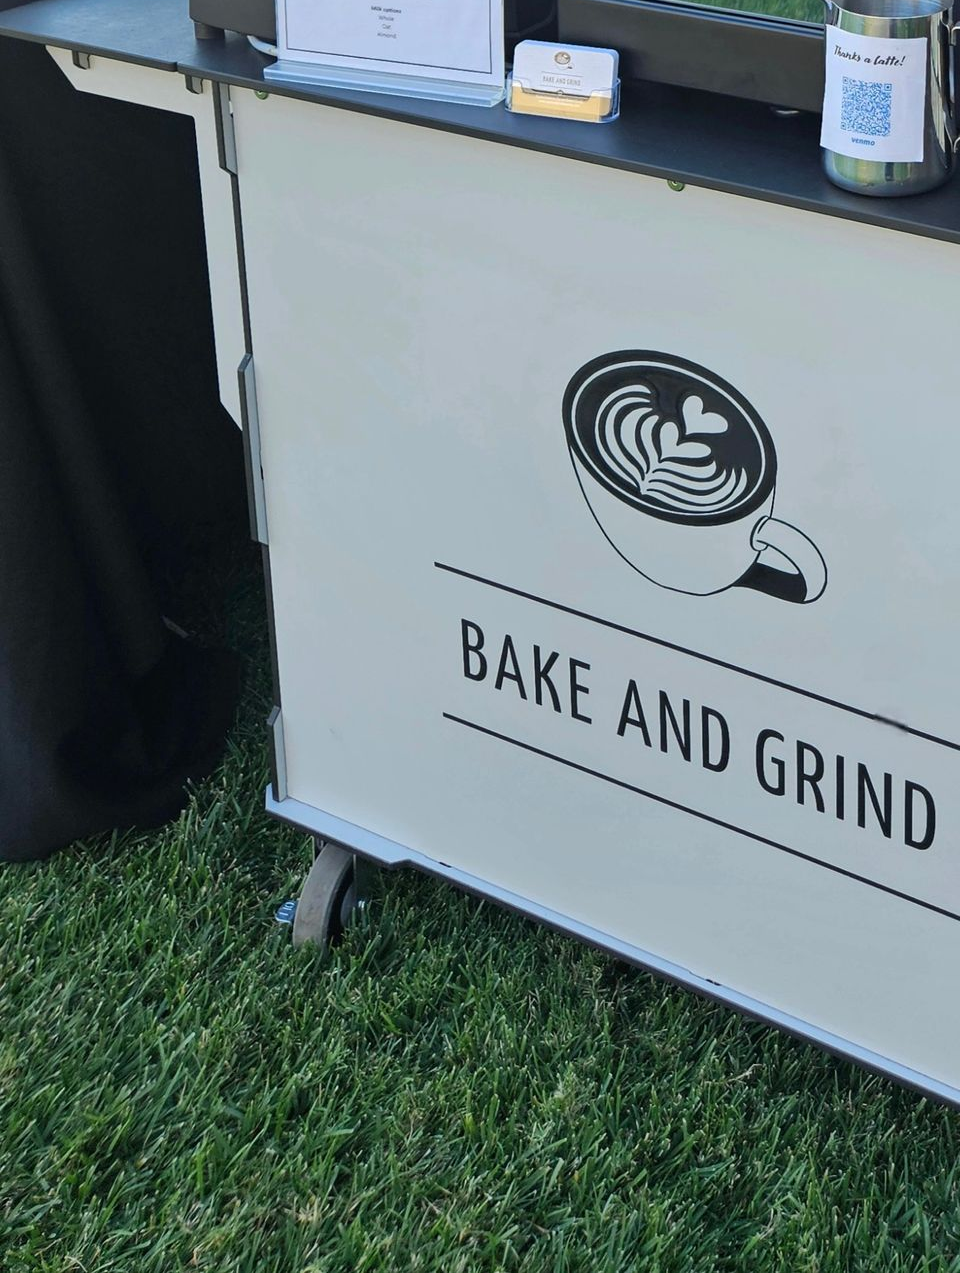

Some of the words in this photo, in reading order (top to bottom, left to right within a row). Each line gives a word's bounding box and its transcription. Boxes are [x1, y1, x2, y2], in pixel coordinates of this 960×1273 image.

[834, 45, 861, 62] Thanks
[851, 137, 876, 146] venmo
[461, 619, 592, 724] BAKE
[617, 679, 730, 773] AND
[756, 729, 937, 851] GRIND
